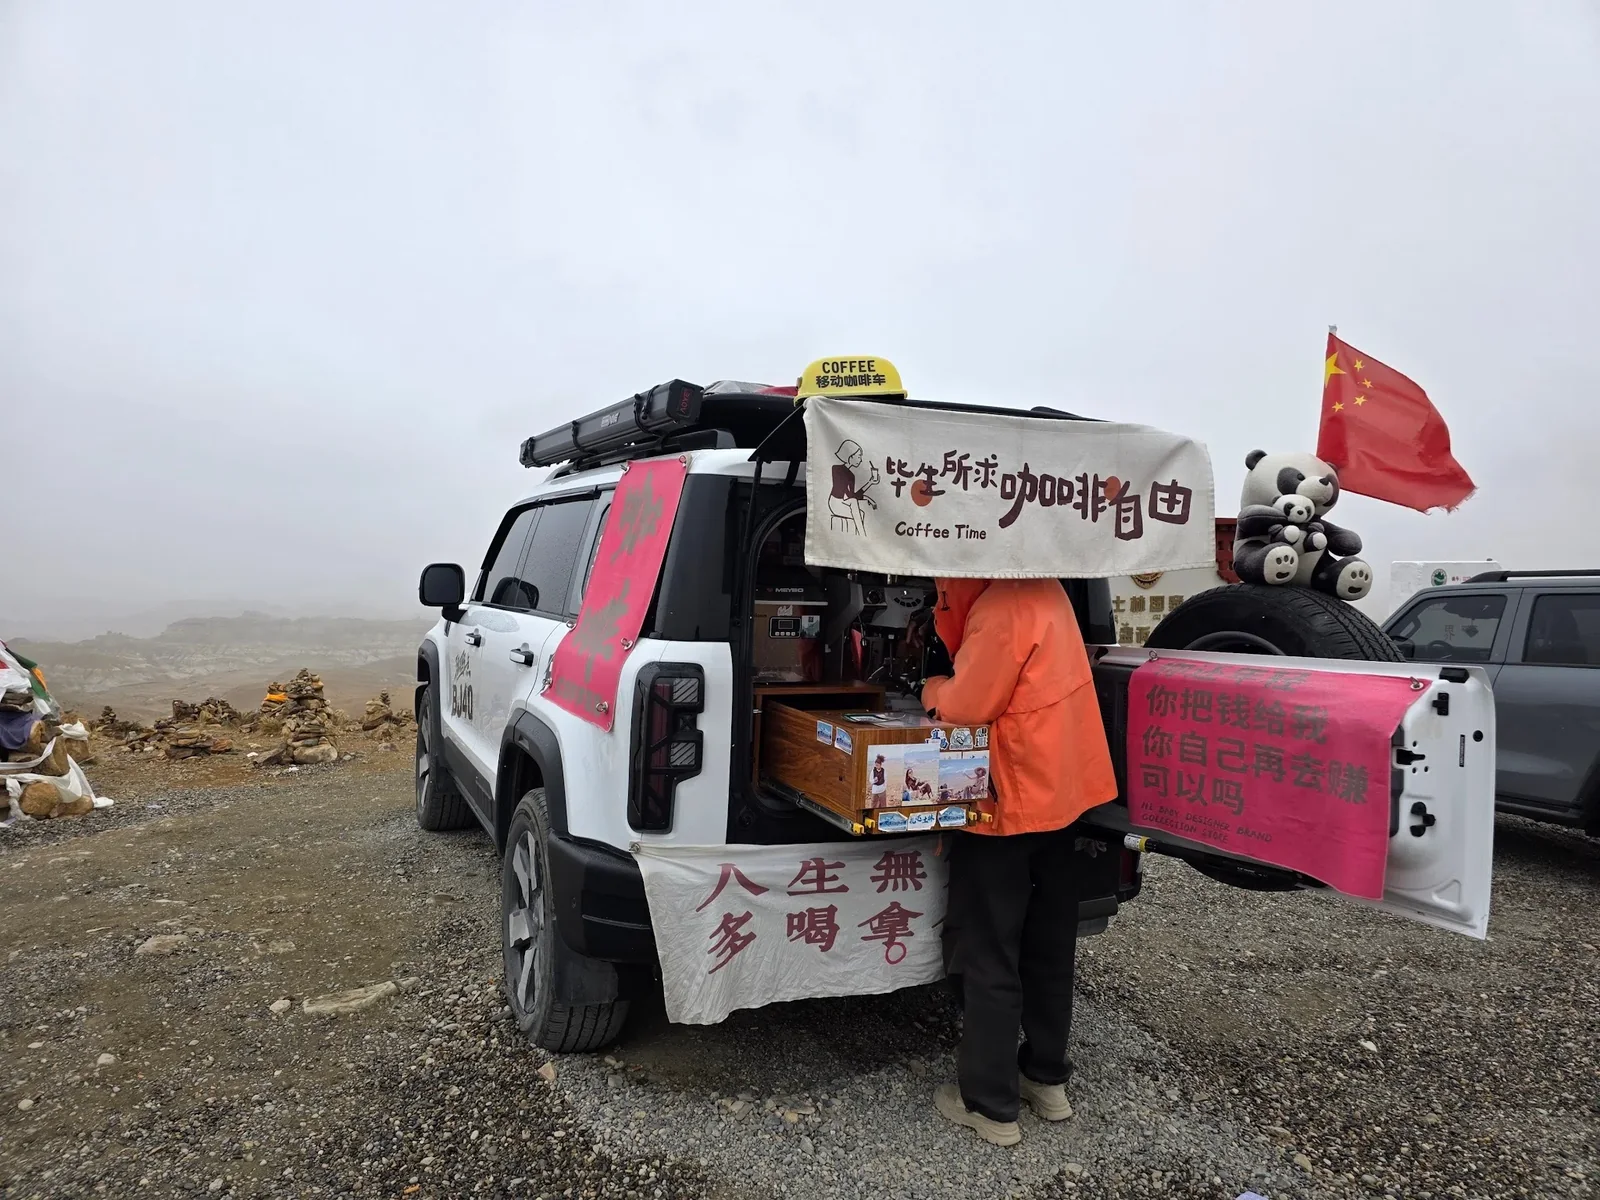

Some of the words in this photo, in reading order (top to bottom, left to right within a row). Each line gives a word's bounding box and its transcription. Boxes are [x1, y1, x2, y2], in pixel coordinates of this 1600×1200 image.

[815, 373, 886, 388] 移动咖啡车
[822, 360, 876, 374] COFFEE
[895, 521, 949, 538] Coffee
[955, 524, 987, 540] Time
[451, 683, 473, 720] BJ40
[1146, 684, 1328, 745] 你把钱给我
[1142, 724, 1368, 804] 你自己再去赚
[1140, 763, 1244, 816] 可以吗
